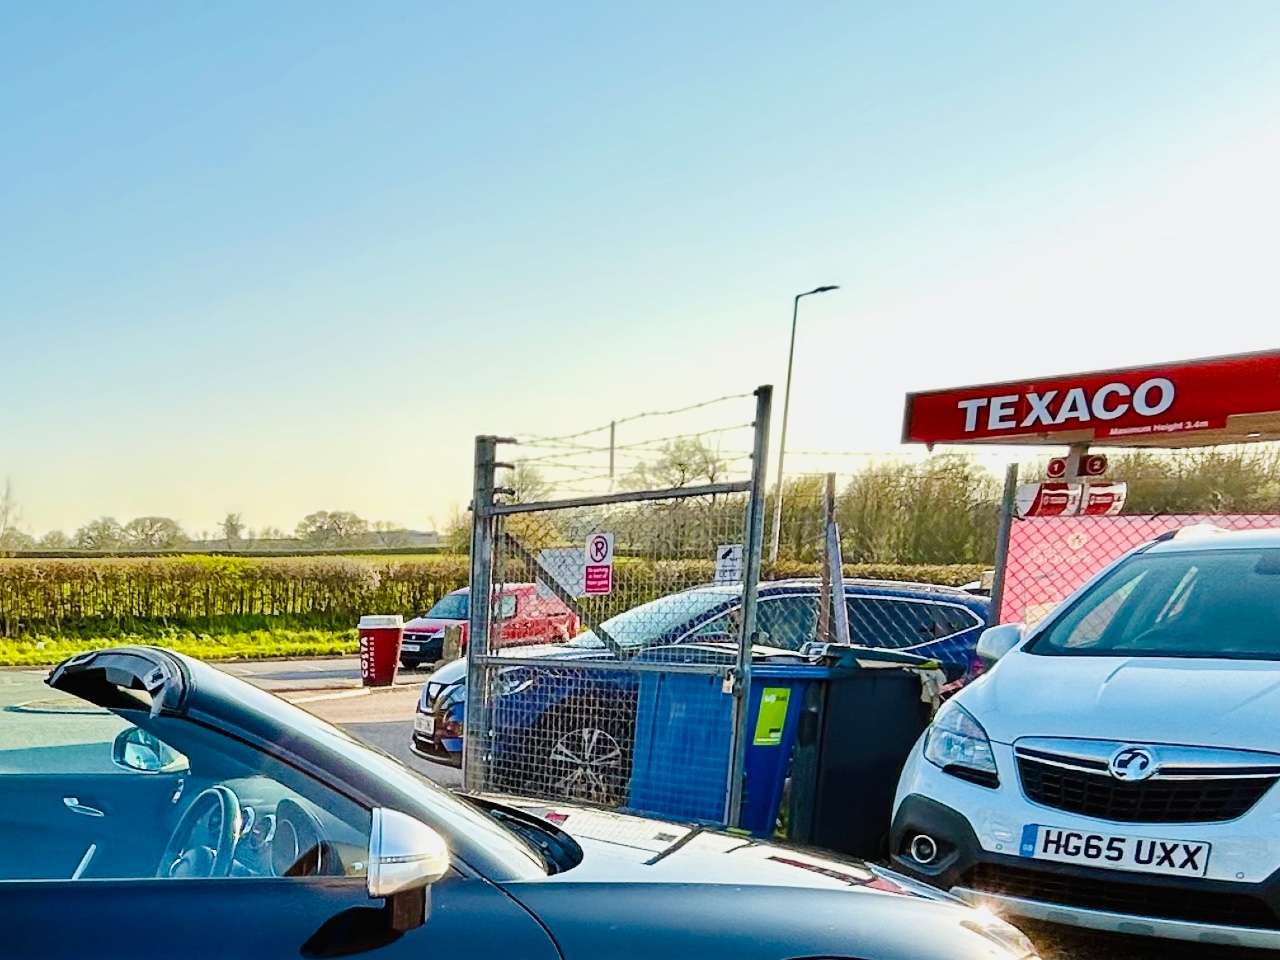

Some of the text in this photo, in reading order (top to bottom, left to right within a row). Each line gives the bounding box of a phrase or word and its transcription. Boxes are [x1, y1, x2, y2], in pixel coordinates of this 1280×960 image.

[957, 377, 1175, 432] TEXACO
[1153, 421, 1183, 432] Height
[361, 636, 369, 678] COSTA
[1042, 829, 1203, 871] HG65 UXX
